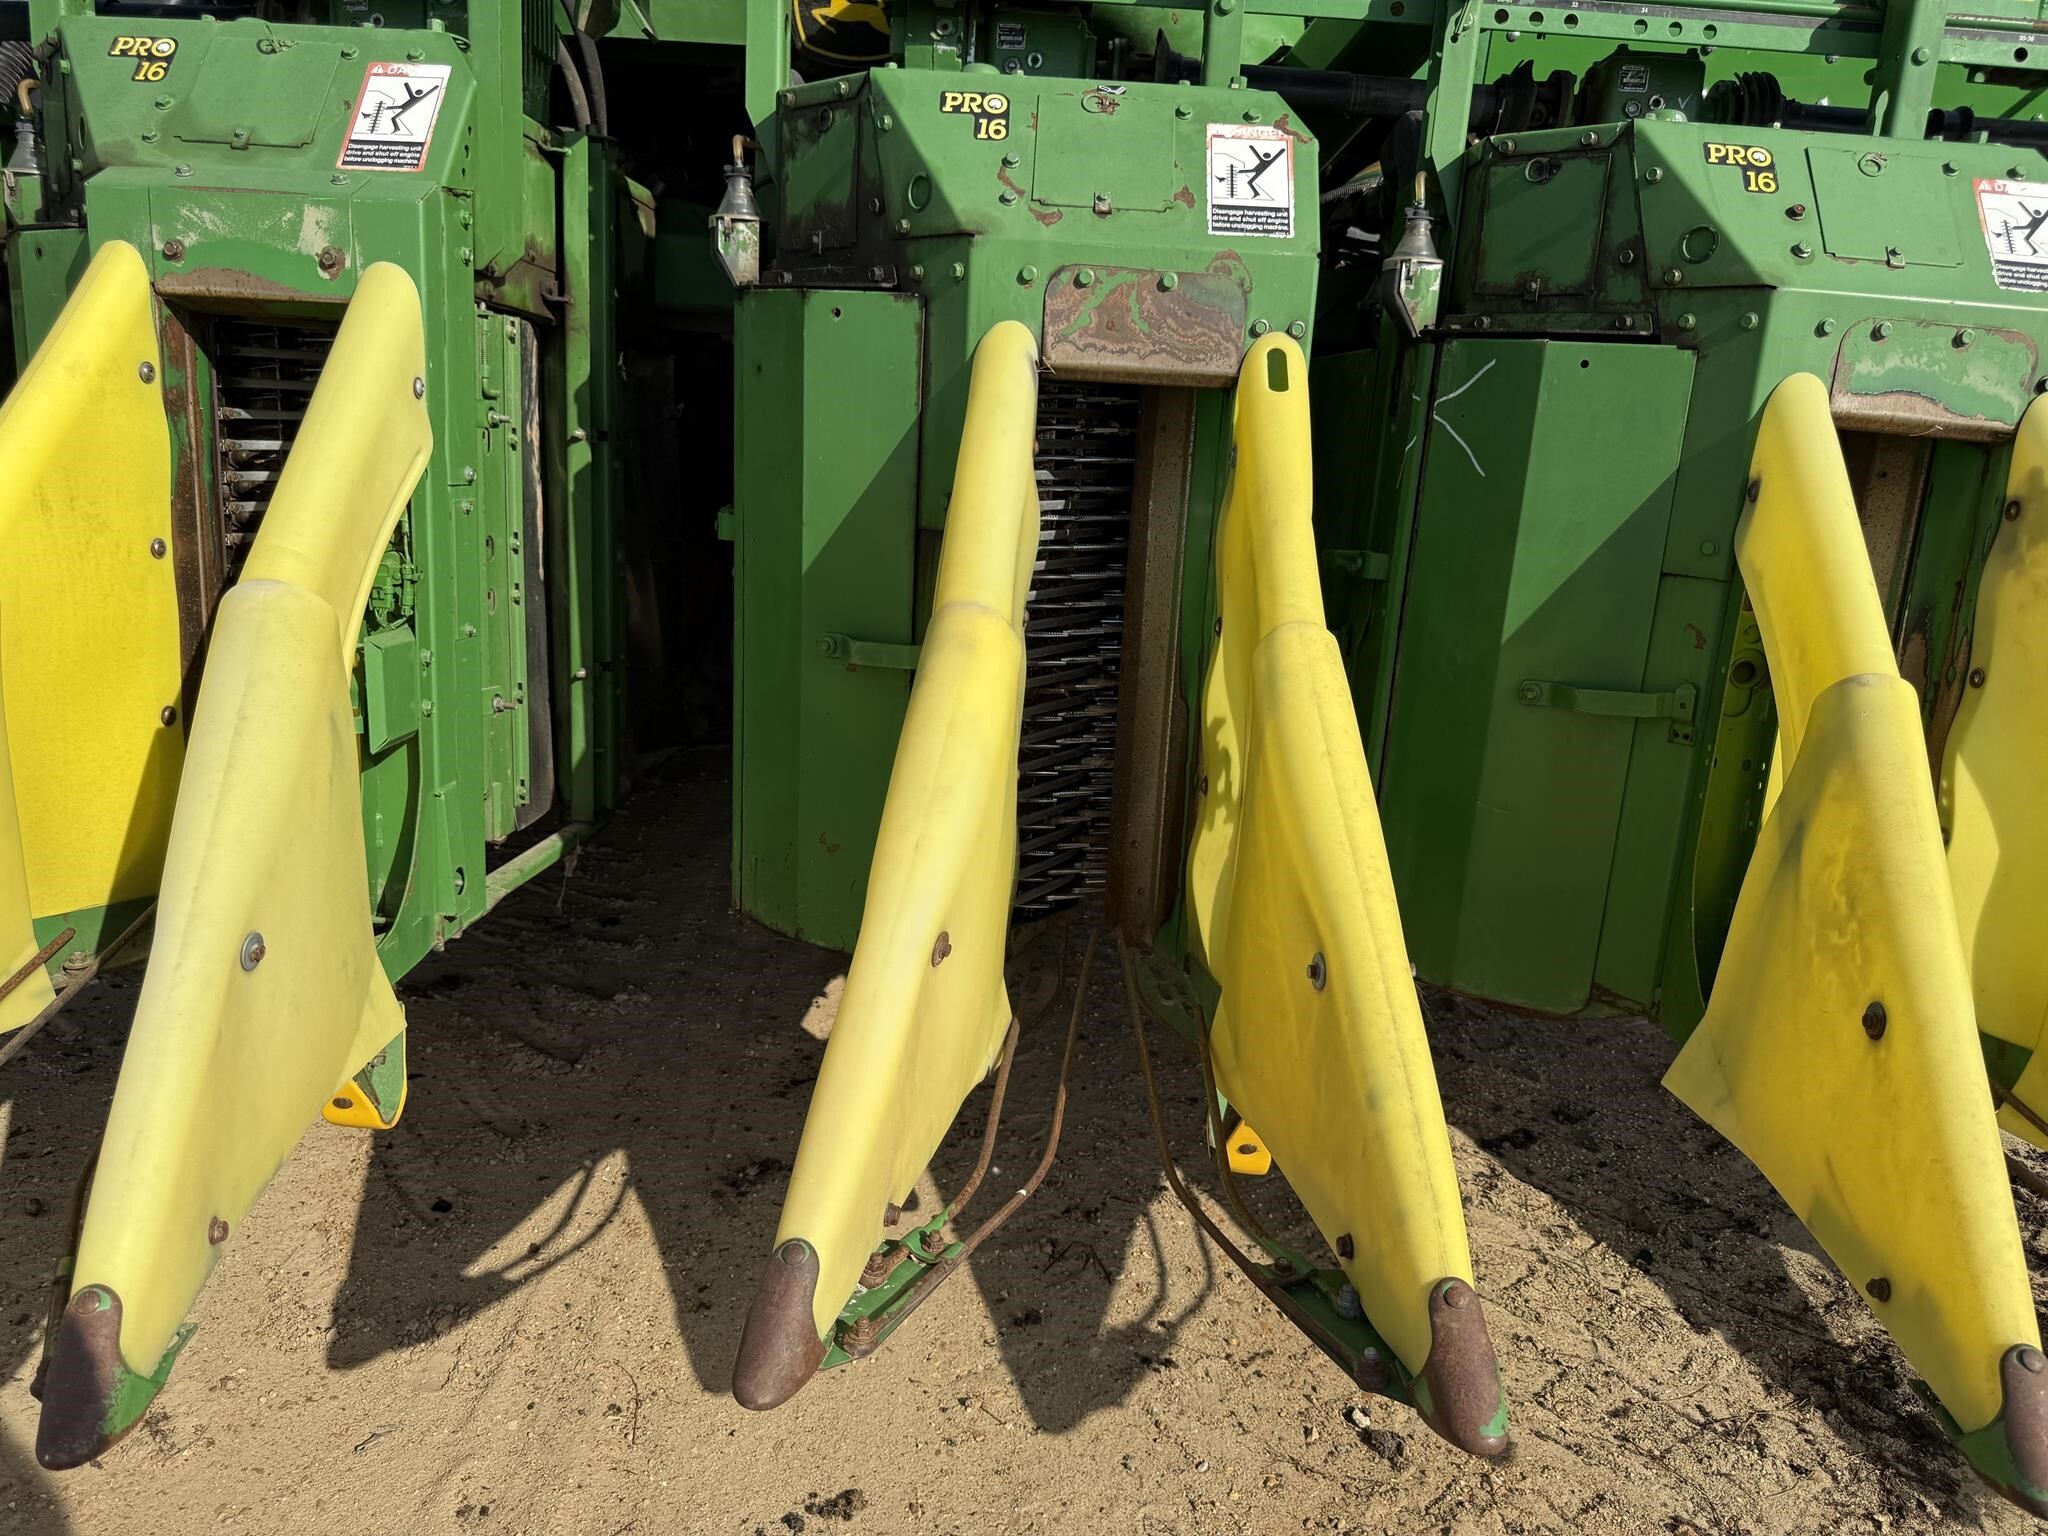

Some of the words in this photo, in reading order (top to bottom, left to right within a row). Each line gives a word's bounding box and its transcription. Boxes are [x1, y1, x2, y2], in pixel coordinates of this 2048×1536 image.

[111, 37, 176, 57] PRO
[134, 61, 168, 81] 16
[942, 92, 1008, 114] PRO
[976, 118, 1007, 140] 16
[1708, 144, 1772, 167] PRO
[1746, 171, 1776, 193] 16
[1244, 209, 1275, 217] harvesting
[2017, 279, 2047, 288] unclogging
